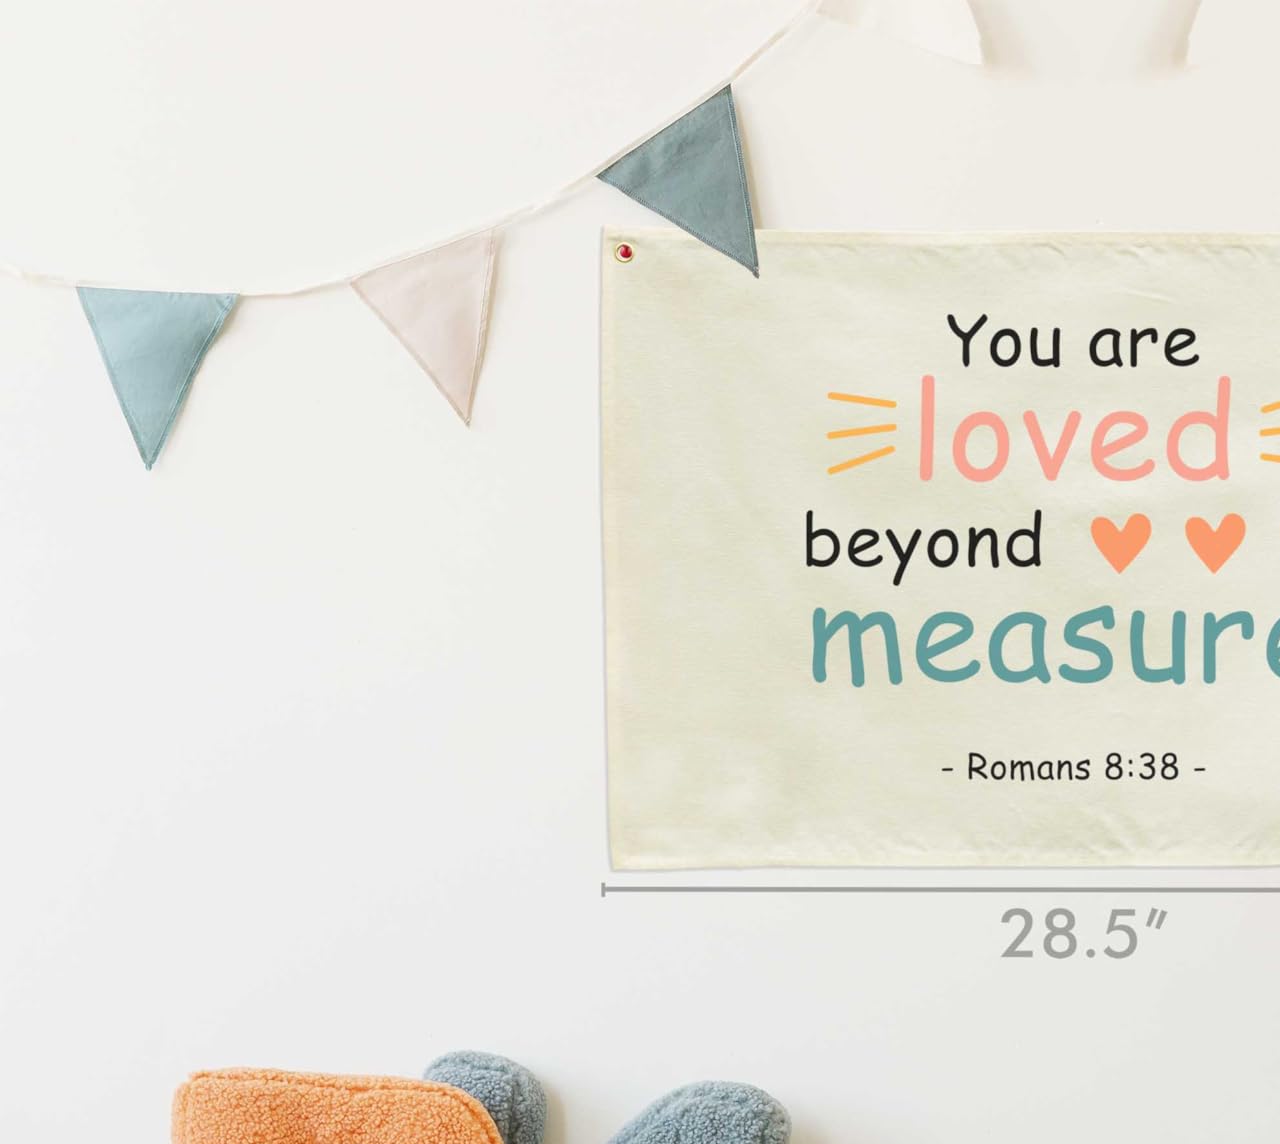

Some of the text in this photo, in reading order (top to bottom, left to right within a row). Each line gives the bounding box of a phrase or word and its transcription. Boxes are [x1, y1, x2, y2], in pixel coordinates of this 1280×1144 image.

[946, 313, 1200, 368] You are
[920, 375, 1230, 481] loved
[805, 508, 1042, 586] beyond
[967, 751, 1091, 781] Romans
[1104, 752, 1180, 781] 8:38
